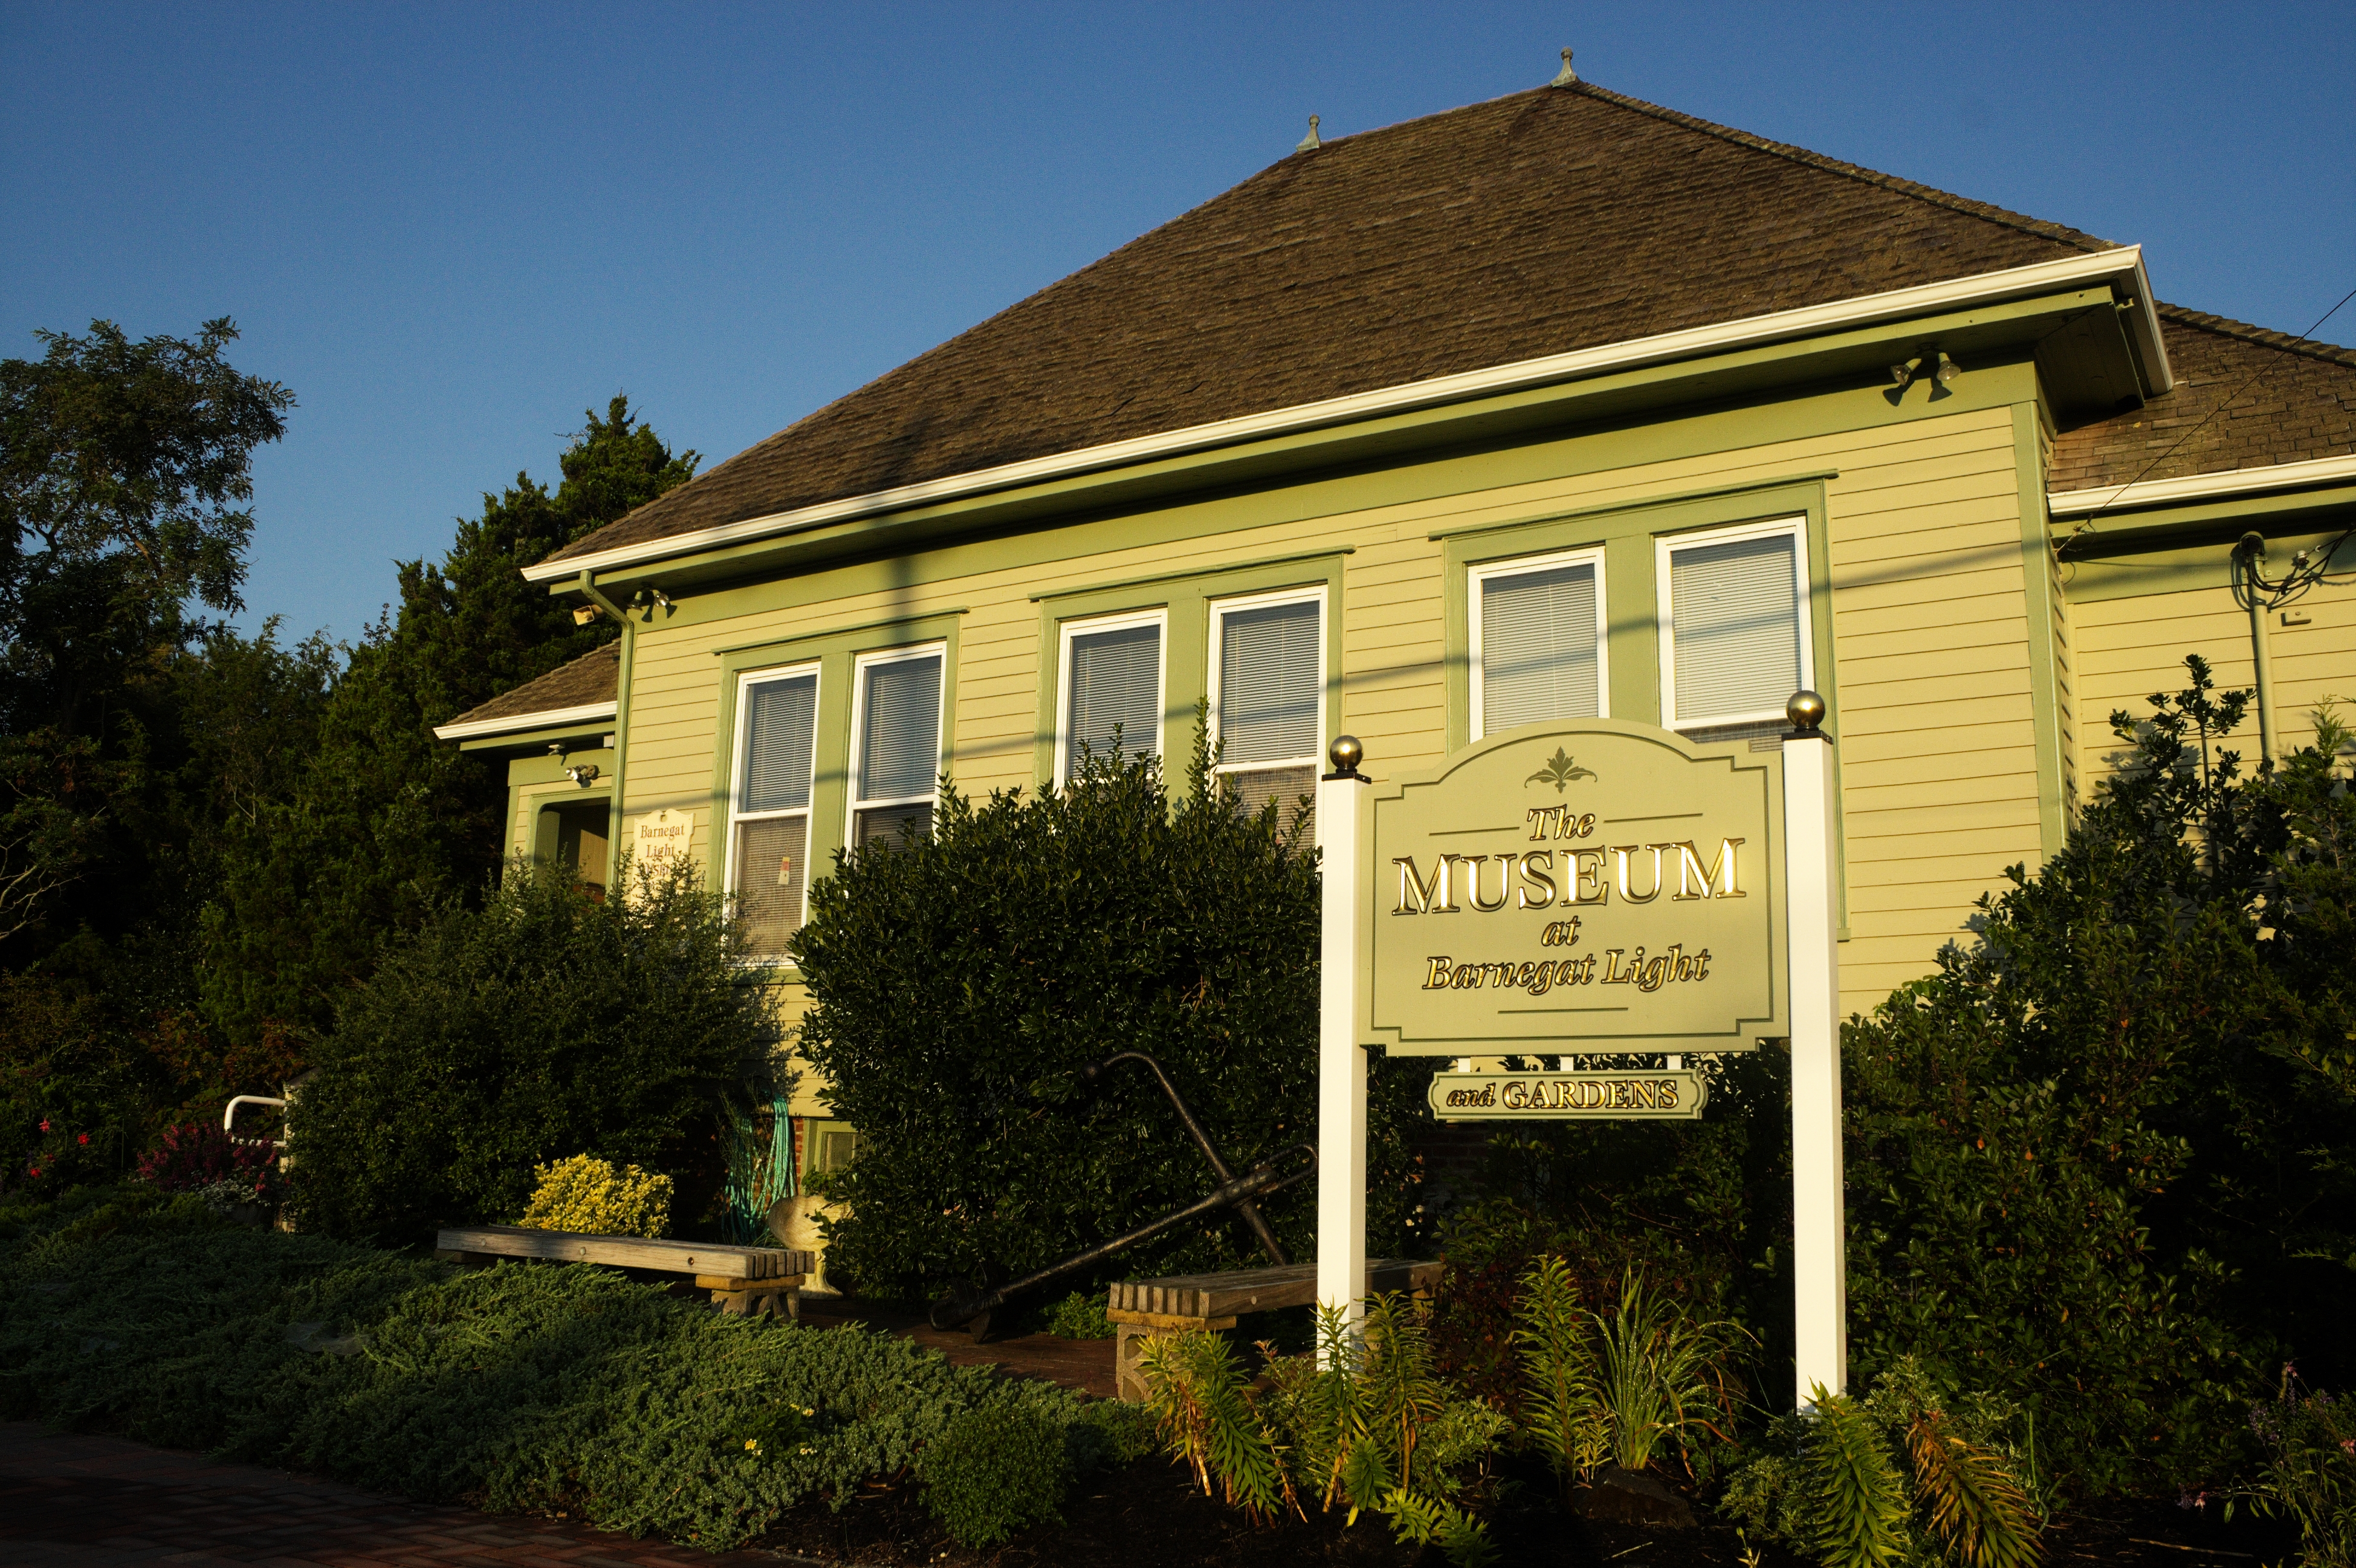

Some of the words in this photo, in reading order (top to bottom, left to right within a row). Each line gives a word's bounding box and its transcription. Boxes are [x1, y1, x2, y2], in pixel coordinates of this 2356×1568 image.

[641, 824, 684, 841] Barnegat
[1527, 803, 1596, 841] The
[646, 843, 675, 858] Light
[1392, 838, 1746, 916] MUSEUM
[1541, 916, 1581, 947] at
[1422, 952, 1596, 996] Barnegat
[1600, 944, 1712, 992] Light
[1446, 1083, 1497, 1108] and
[1503, 1080, 1679, 1110] GARDENS
